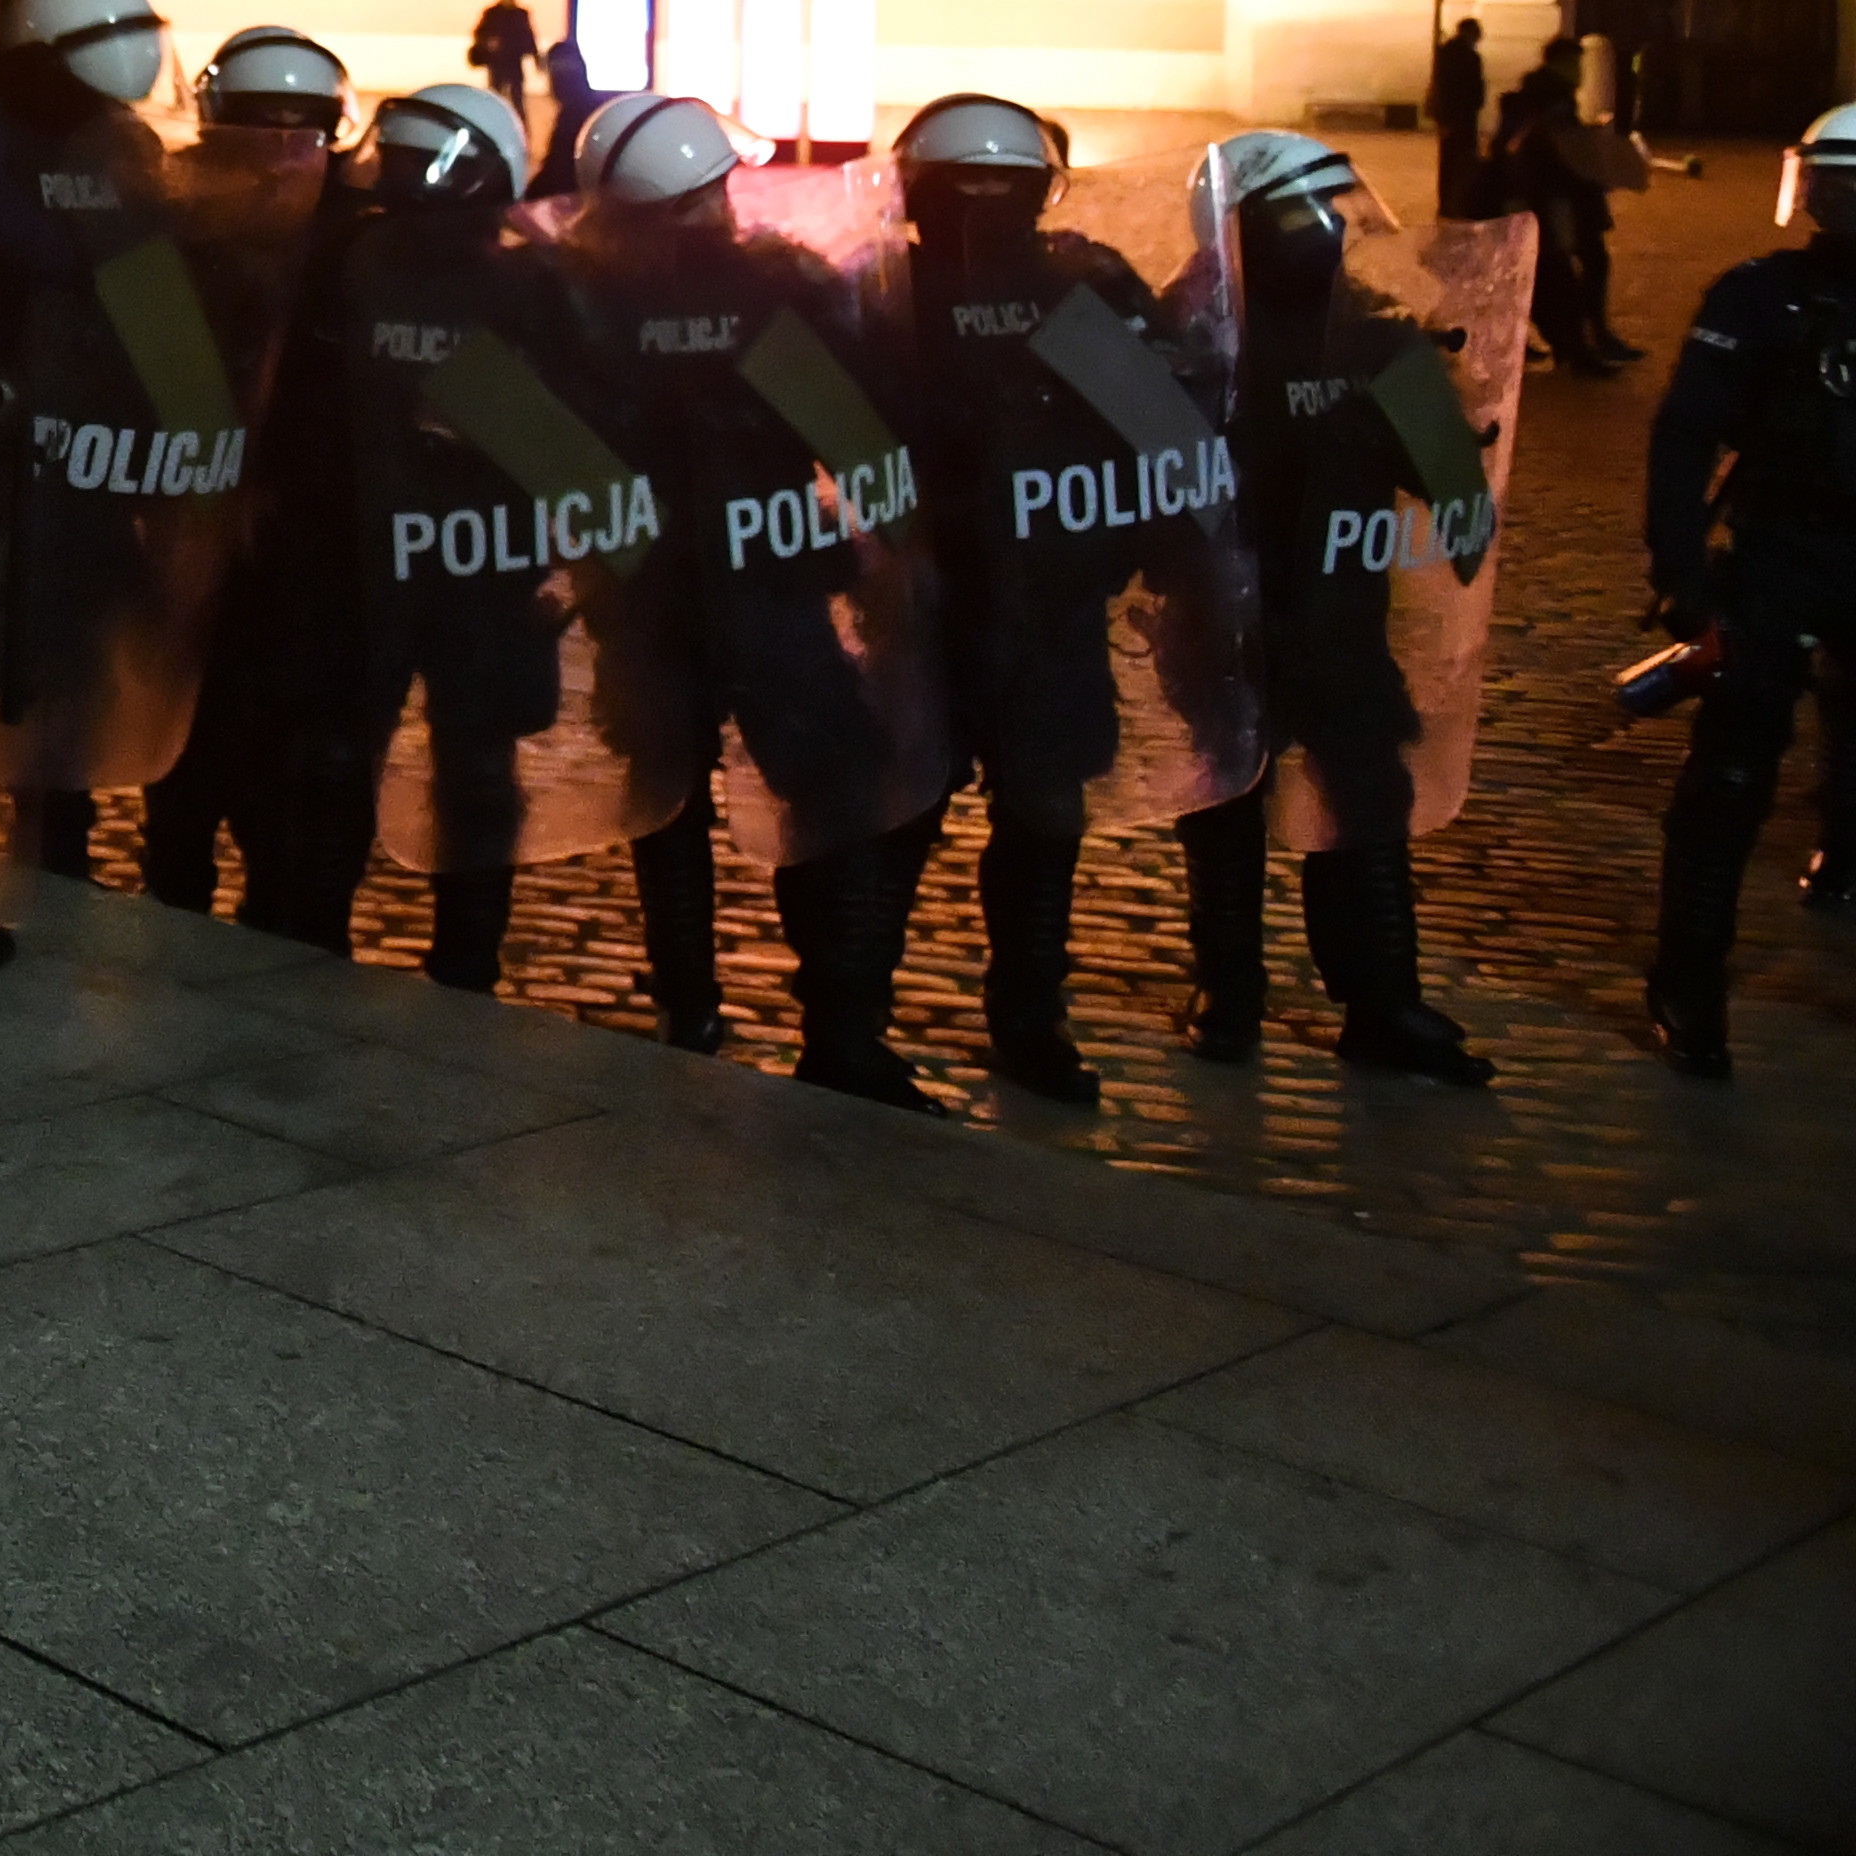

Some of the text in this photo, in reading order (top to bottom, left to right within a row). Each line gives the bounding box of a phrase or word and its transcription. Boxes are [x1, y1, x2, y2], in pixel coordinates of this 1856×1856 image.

[31, 415, 246, 497] POLICJA
[726, 445, 917, 570] POLICJA
[1012, 435, 1236, 539] POLICJA
[392, 474, 661, 581] POLICJA
